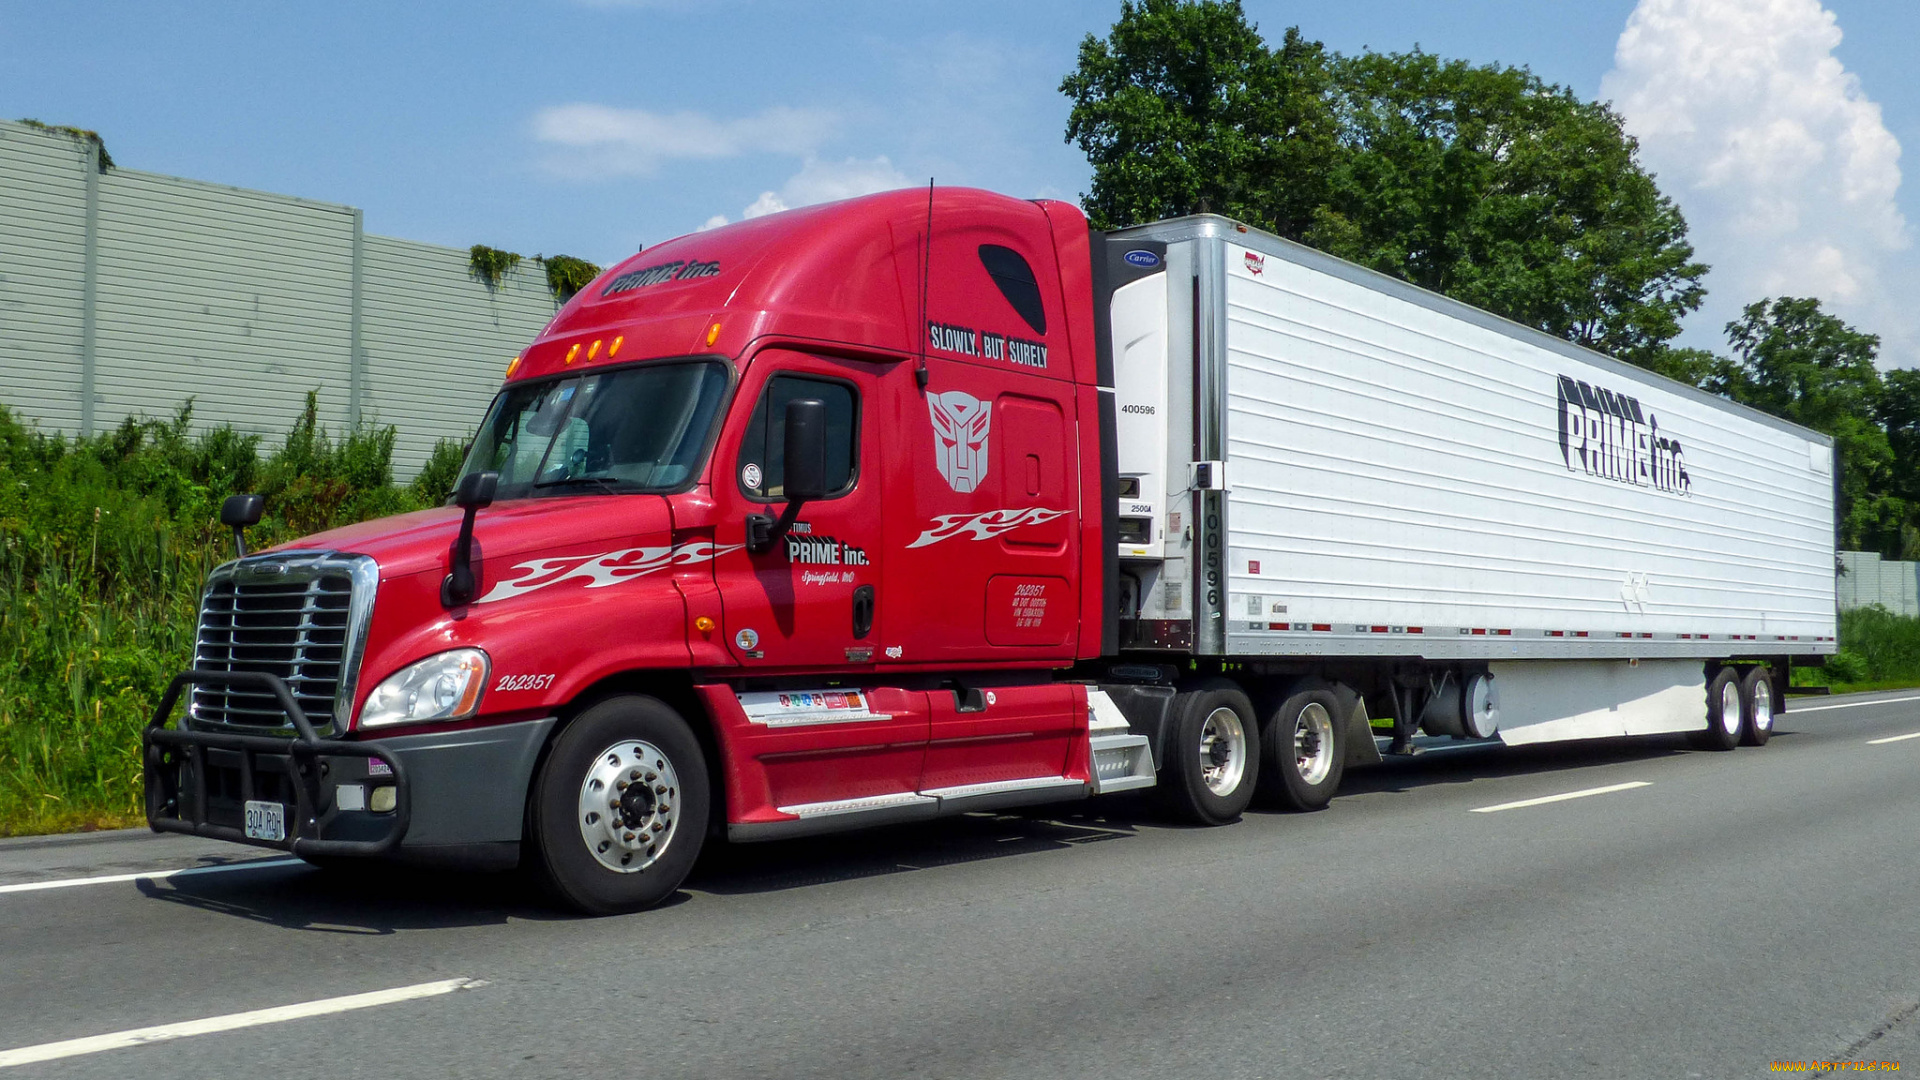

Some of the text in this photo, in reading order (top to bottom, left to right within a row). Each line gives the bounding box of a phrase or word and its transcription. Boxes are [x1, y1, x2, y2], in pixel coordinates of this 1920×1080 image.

[1129, 253, 1157, 264] Carrier
[601, 259, 720, 297] PRIME inc.
[929, 323, 1048, 369] SLOWLY, BUT SURELY
[1121, 404, 1156, 415] 400596
[1566, 400, 1648, 488] PRIME
[788, 522, 812, 534] TIMUS
[788, 541, 870, 566] PRIME inc.
[494, 673, 556, 692] 262351
